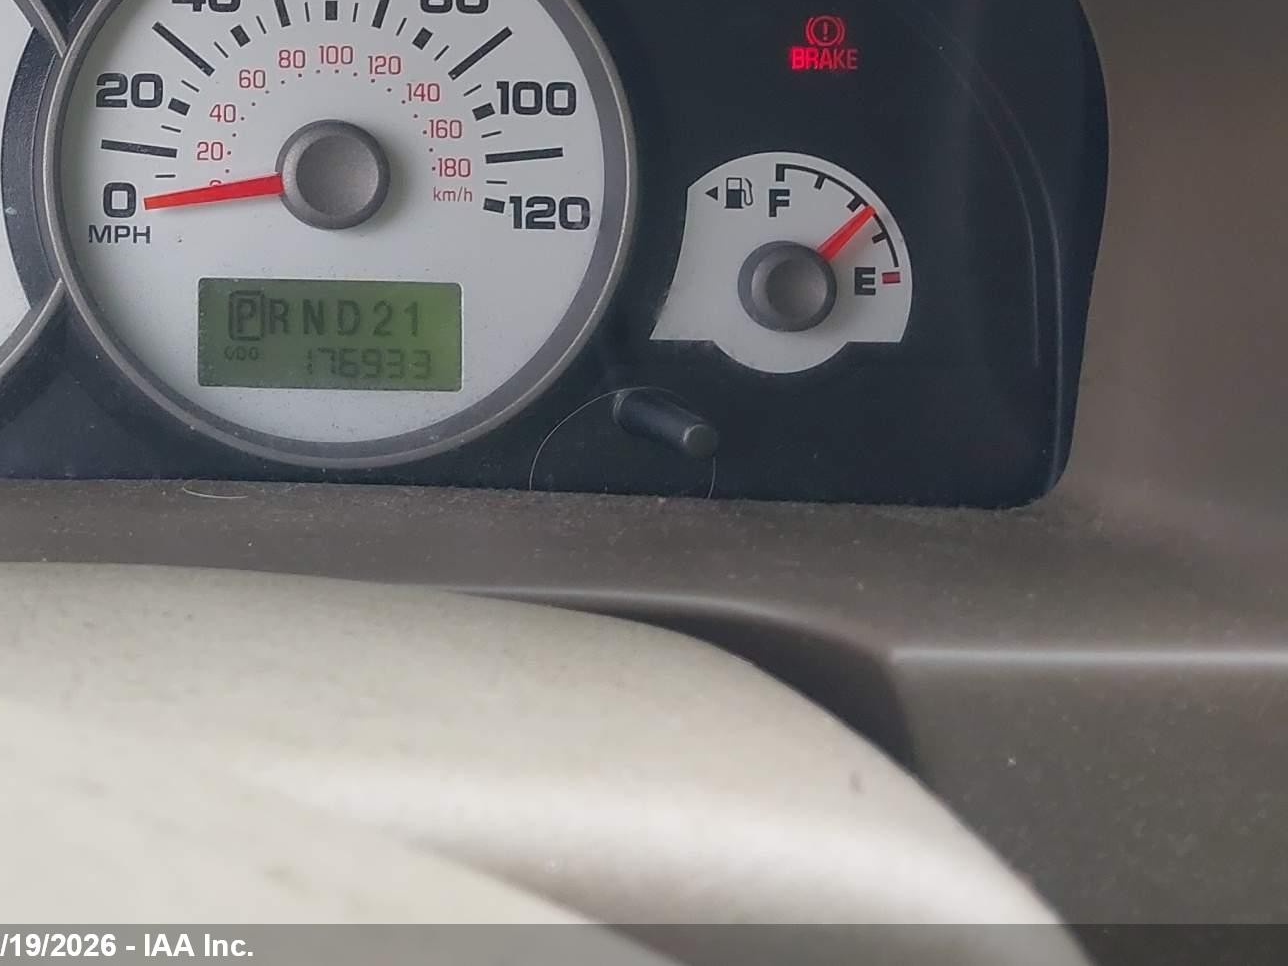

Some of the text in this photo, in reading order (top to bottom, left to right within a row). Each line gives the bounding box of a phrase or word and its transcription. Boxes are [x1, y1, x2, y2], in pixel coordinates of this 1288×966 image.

[279, 50, 305, 68] 80
[320, 46, 353, 64] 100
[791, 48, 857, 70] BRAKE
[368, 56, 401, 74] 120
[239, 70, 265, 88] 60
[96, 73, 163, 108] 20
[407, 83, 440, 102] 140
[497, 81, 576, 115] 100
[210, 104, 236, 122] 40
[430, 120, 462, 138] 160
[197, 142, 223, 160] 20
[438, 158, 470, 177] 180
[103, 183, 136, 218] 0
[434, 186, 472, 202] km/h
[769, 189, 790, 217] F
[509, 196, 590, 230] 120
[88, 225, 150, 243] MPH
[854, 267, 876, 295] E
